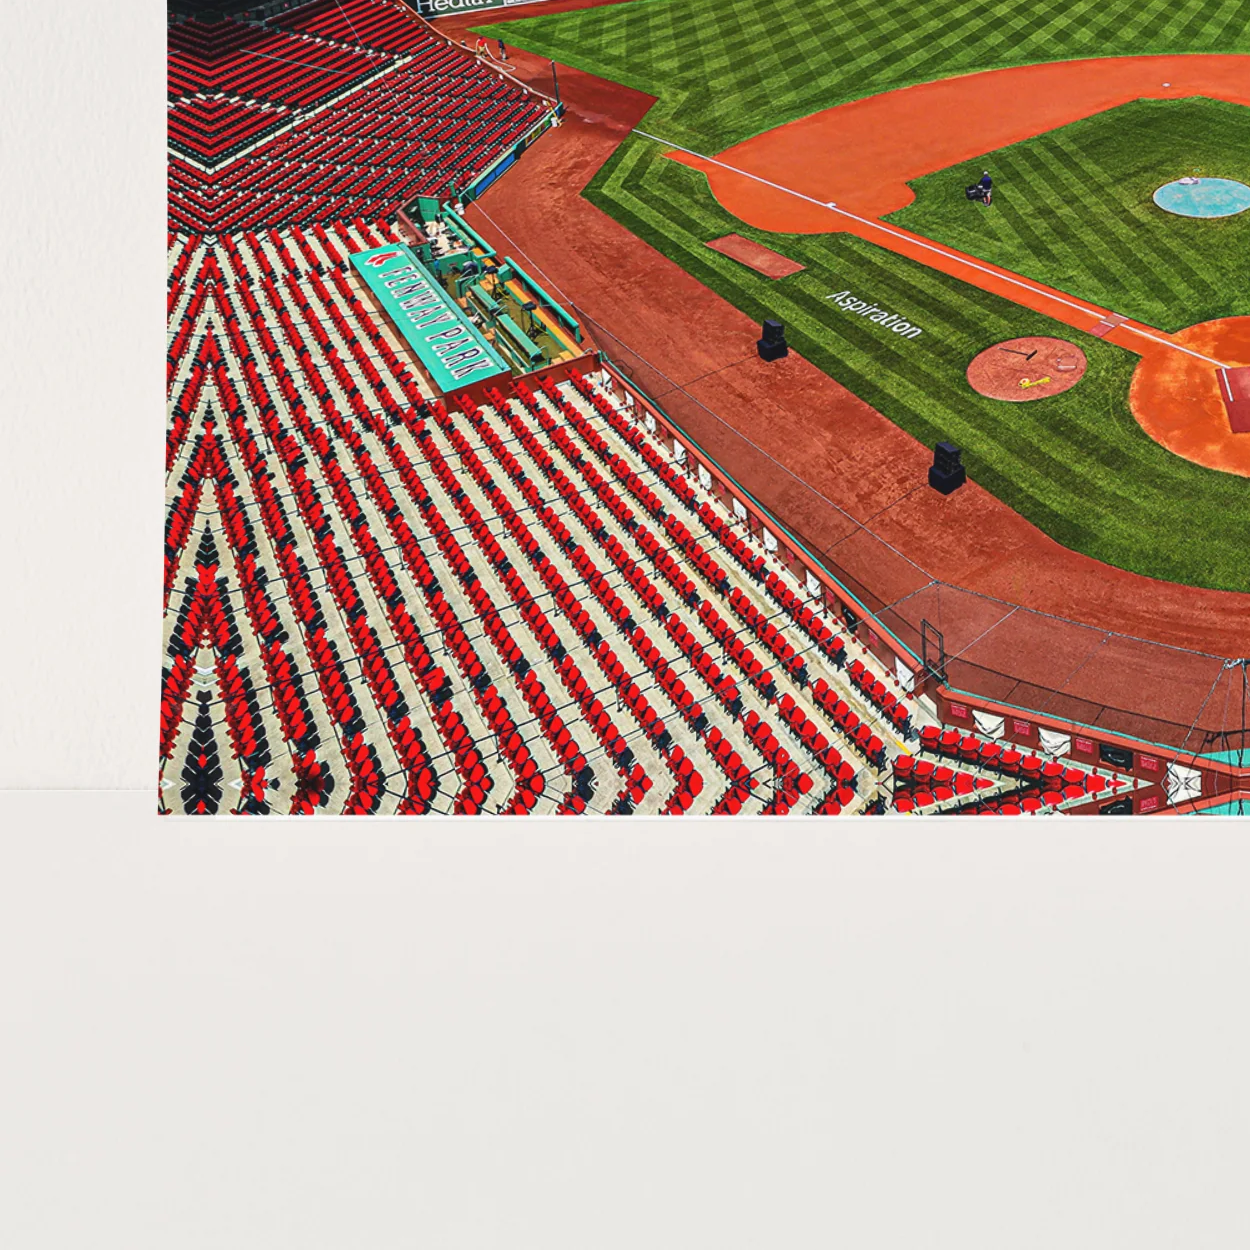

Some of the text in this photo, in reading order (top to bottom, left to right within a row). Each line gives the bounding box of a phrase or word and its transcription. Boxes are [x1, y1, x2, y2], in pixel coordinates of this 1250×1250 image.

[378, 265, 495, 381] FENWAY PARK
[825, 290, 923, 339] Aspiration
